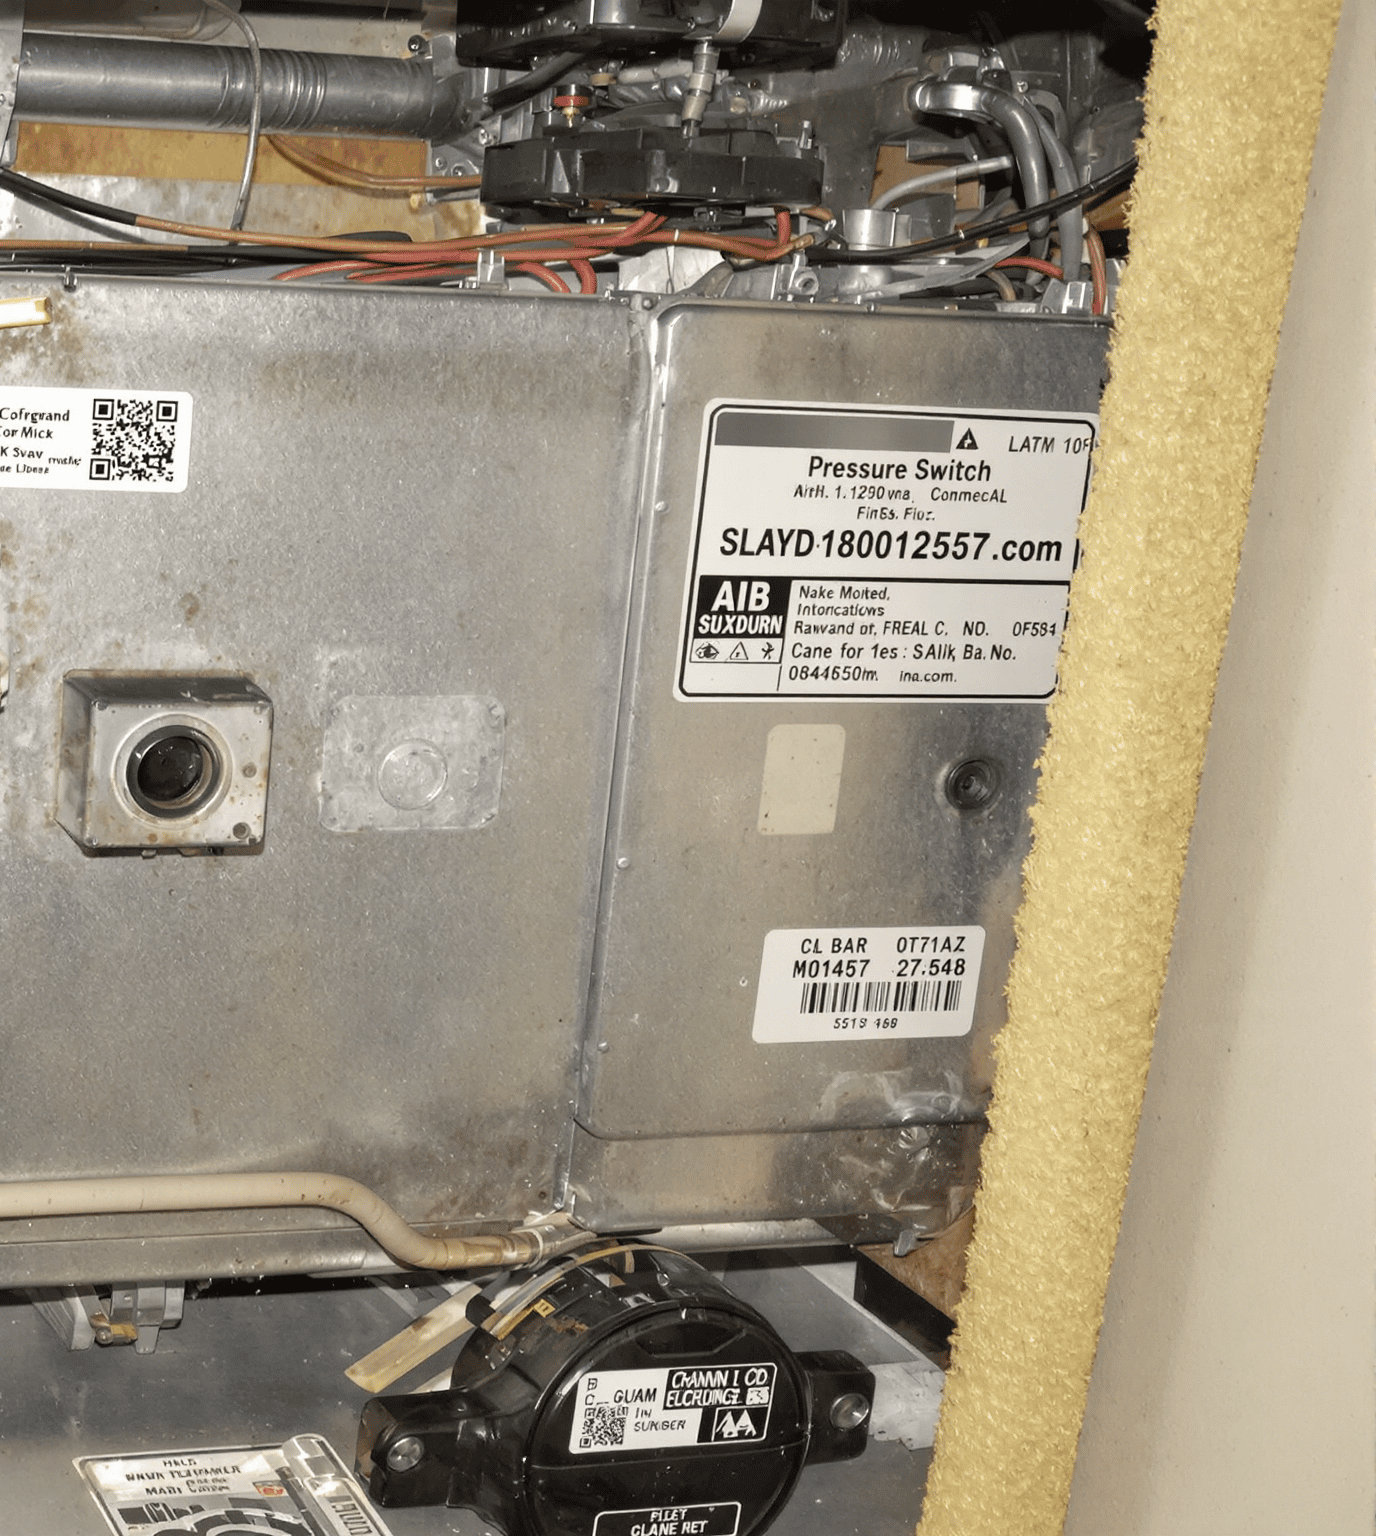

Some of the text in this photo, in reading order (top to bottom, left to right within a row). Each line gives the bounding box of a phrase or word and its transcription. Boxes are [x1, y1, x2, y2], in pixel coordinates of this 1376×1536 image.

[1008, 435, 1056, 454] LATM
[808, 455, 992, 482] Pressure Switch
[710, 580, 771, 612] AIB
[799, 585, 835, 600] Nake
[698, 613, 784, 635] SUXDURN
[882, 621, 929, 636] FREAL
[791, 642, 833, 660] Cane
[839, 642, 864, 660] for
[990, 644, 1017, 661] No.
[831, 937, 868, 954] BAR
[613, 1387, 657, 1404] GUAM
[681, 1520, 709, 1534] RET
